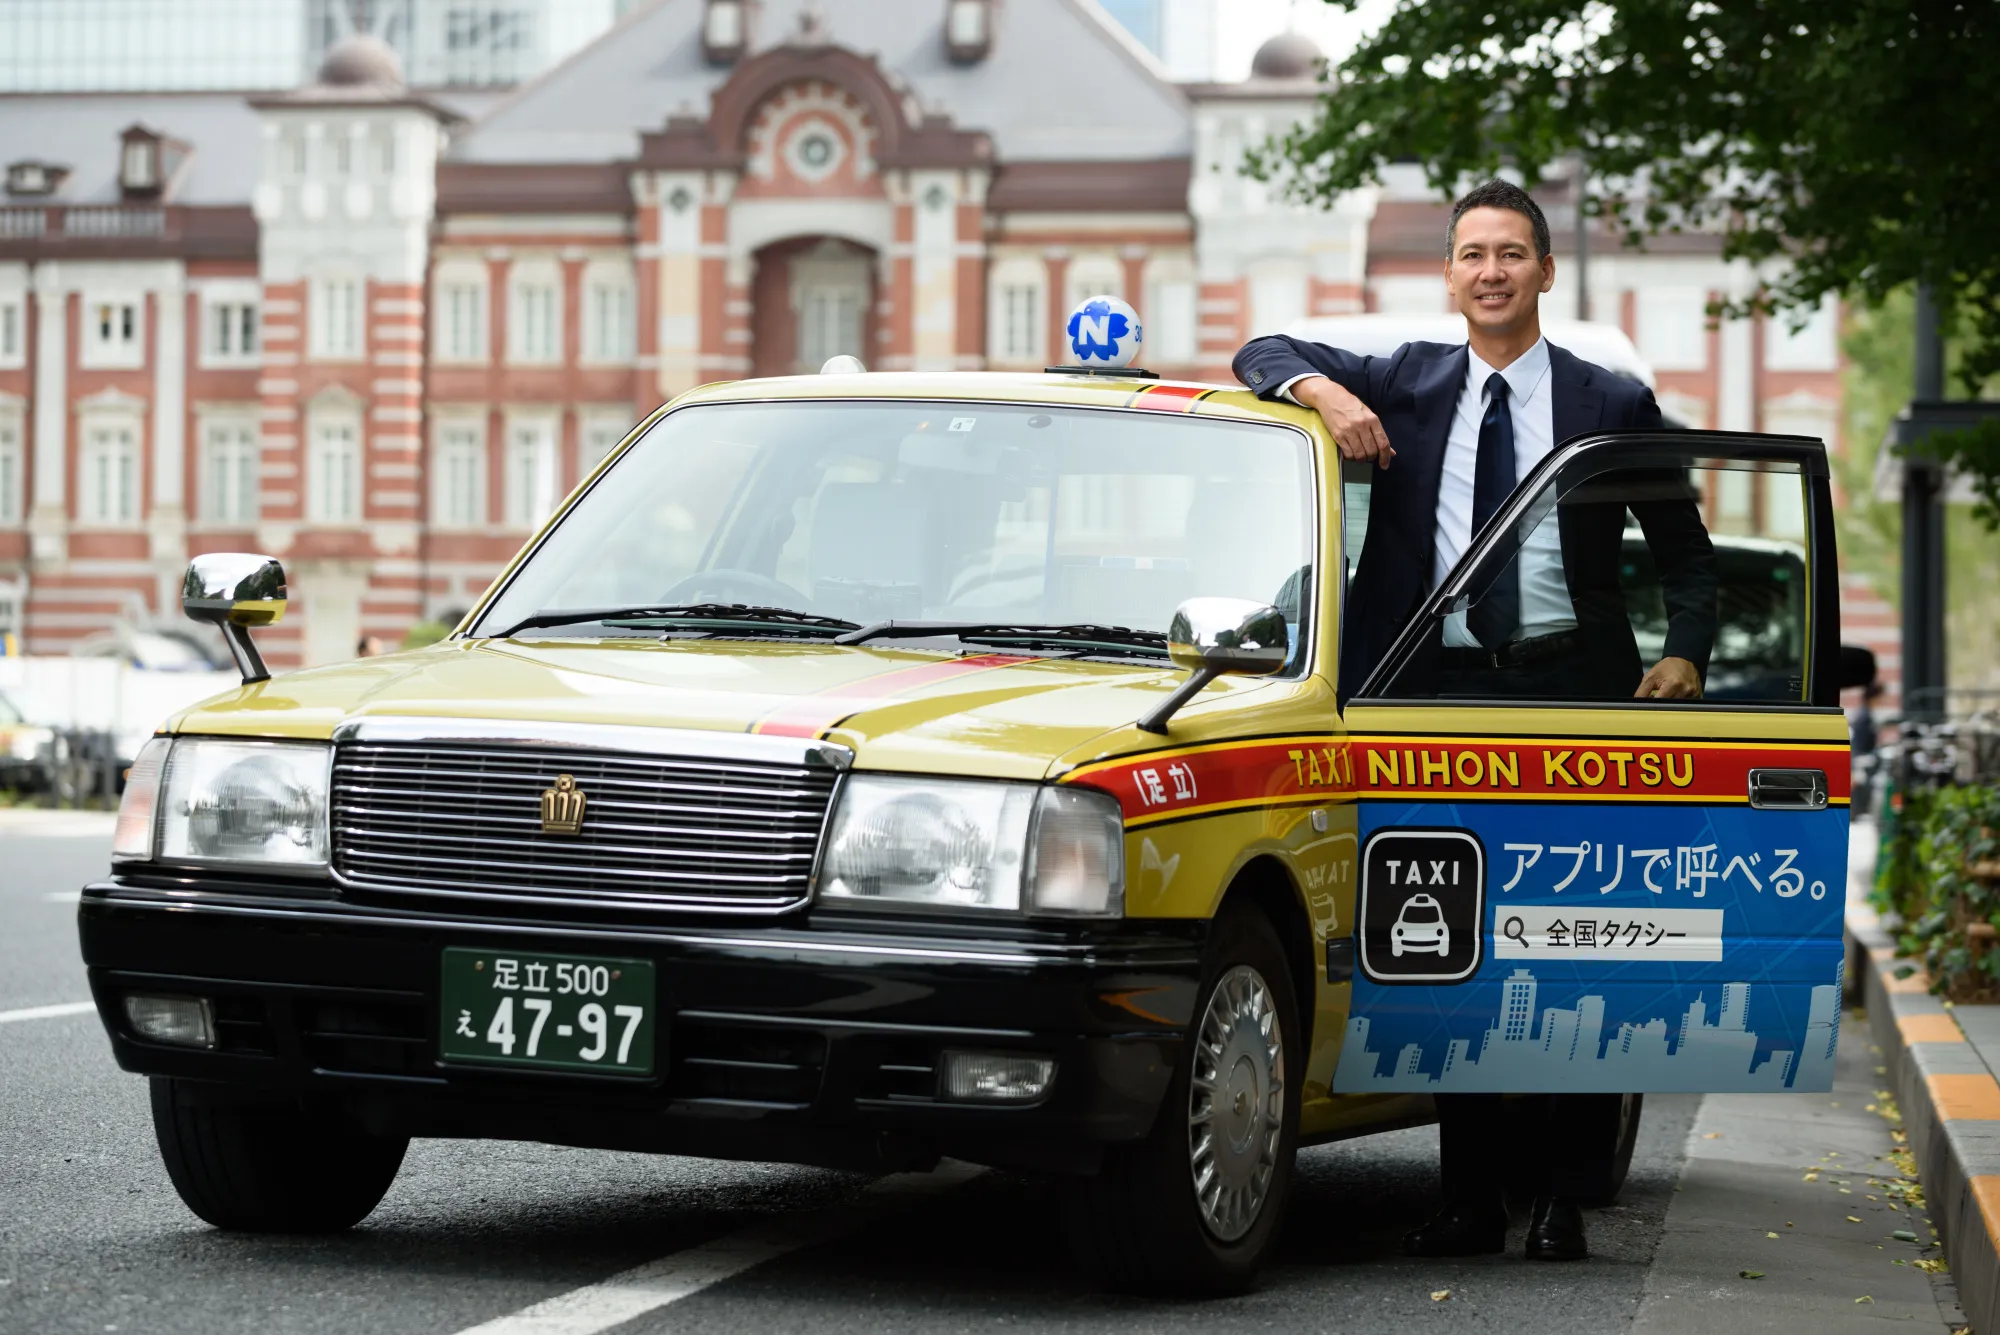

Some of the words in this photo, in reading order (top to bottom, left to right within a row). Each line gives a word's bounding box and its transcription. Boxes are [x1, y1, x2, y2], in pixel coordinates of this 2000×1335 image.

[1078, 315, 1110, 346] N
[1288, 748, 1351, 786] TAXI
[1367, 749, 1520, 787] NIHON
[1543, 750, 1694, 788] KOTSU
[1386, 860, 1460, 885] TAXI
[1502, 840, 1827, 900] アプリで呼べる。
[1546, 918, 1687, 949] 全国タクシー
[456, 1009, 477, 1038] え
[487, 997, 644, 1065] 47-97
